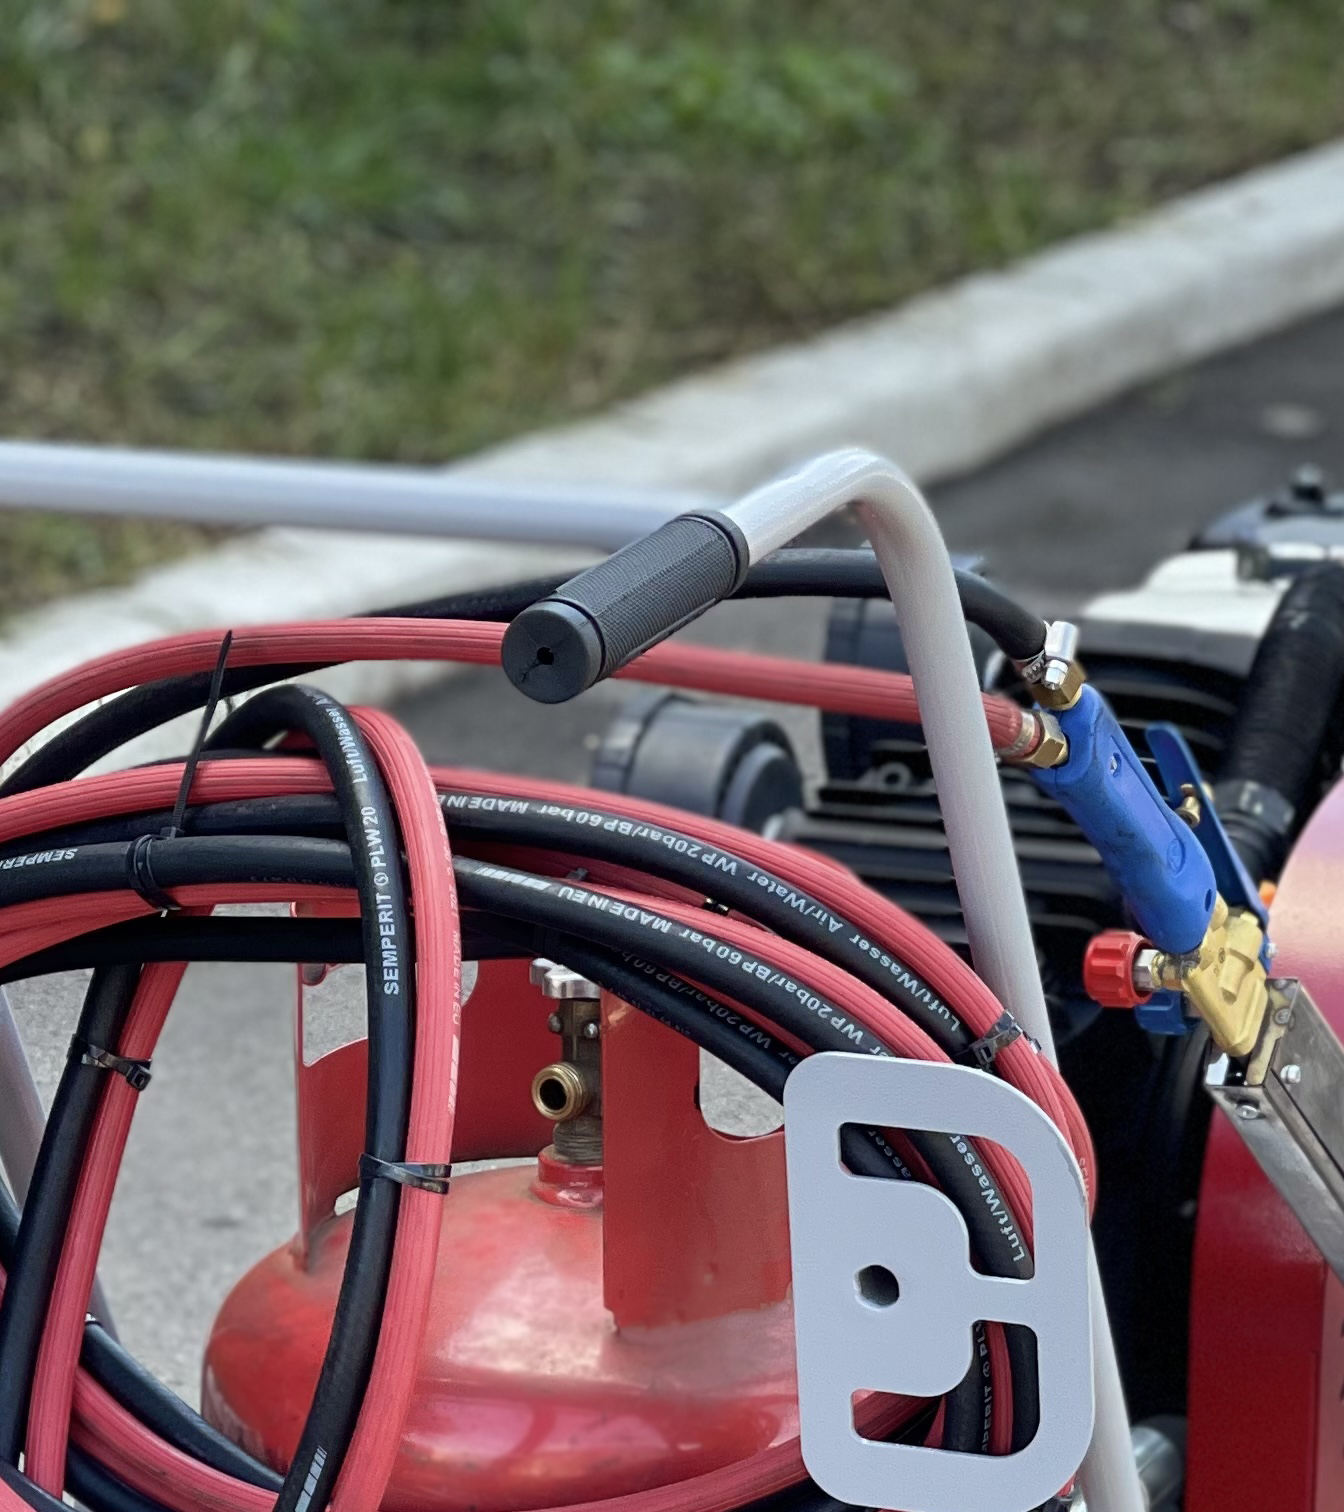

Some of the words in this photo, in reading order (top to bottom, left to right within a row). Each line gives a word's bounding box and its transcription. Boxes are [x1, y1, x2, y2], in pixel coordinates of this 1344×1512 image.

[360, 806, 378, 827] 20
[468, 796, 530, 814] MADE
[364, 829, 387, 868] PLW
[607, 901, 673, 934] MADE
[746, 870, 844, 933] Air/Water
[375, 893, 399, 995] SEMPERIT
[848, 932, 961, 1032] Luft/Wasser
[948, 1134, 1026, 1262] Luft/Wasser
